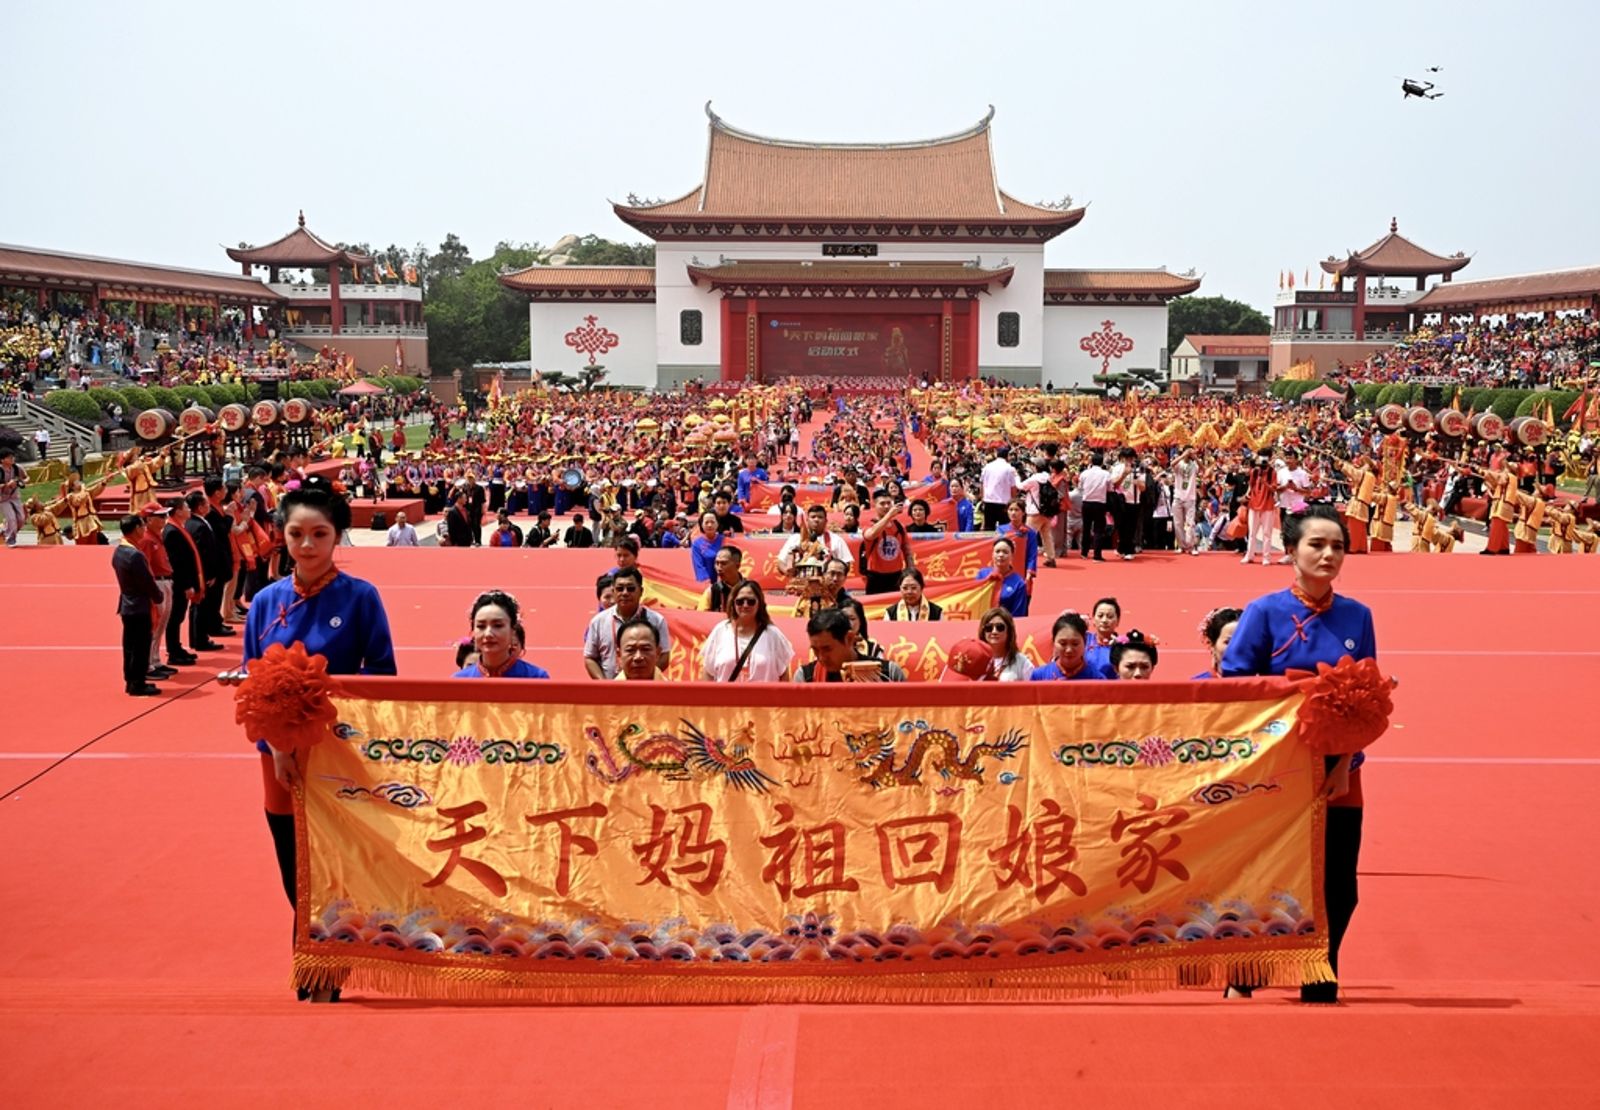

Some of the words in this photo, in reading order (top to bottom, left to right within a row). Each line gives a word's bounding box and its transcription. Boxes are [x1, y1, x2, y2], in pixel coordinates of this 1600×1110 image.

[423, 798, 1191, 902] 天下妈祖回娘家
